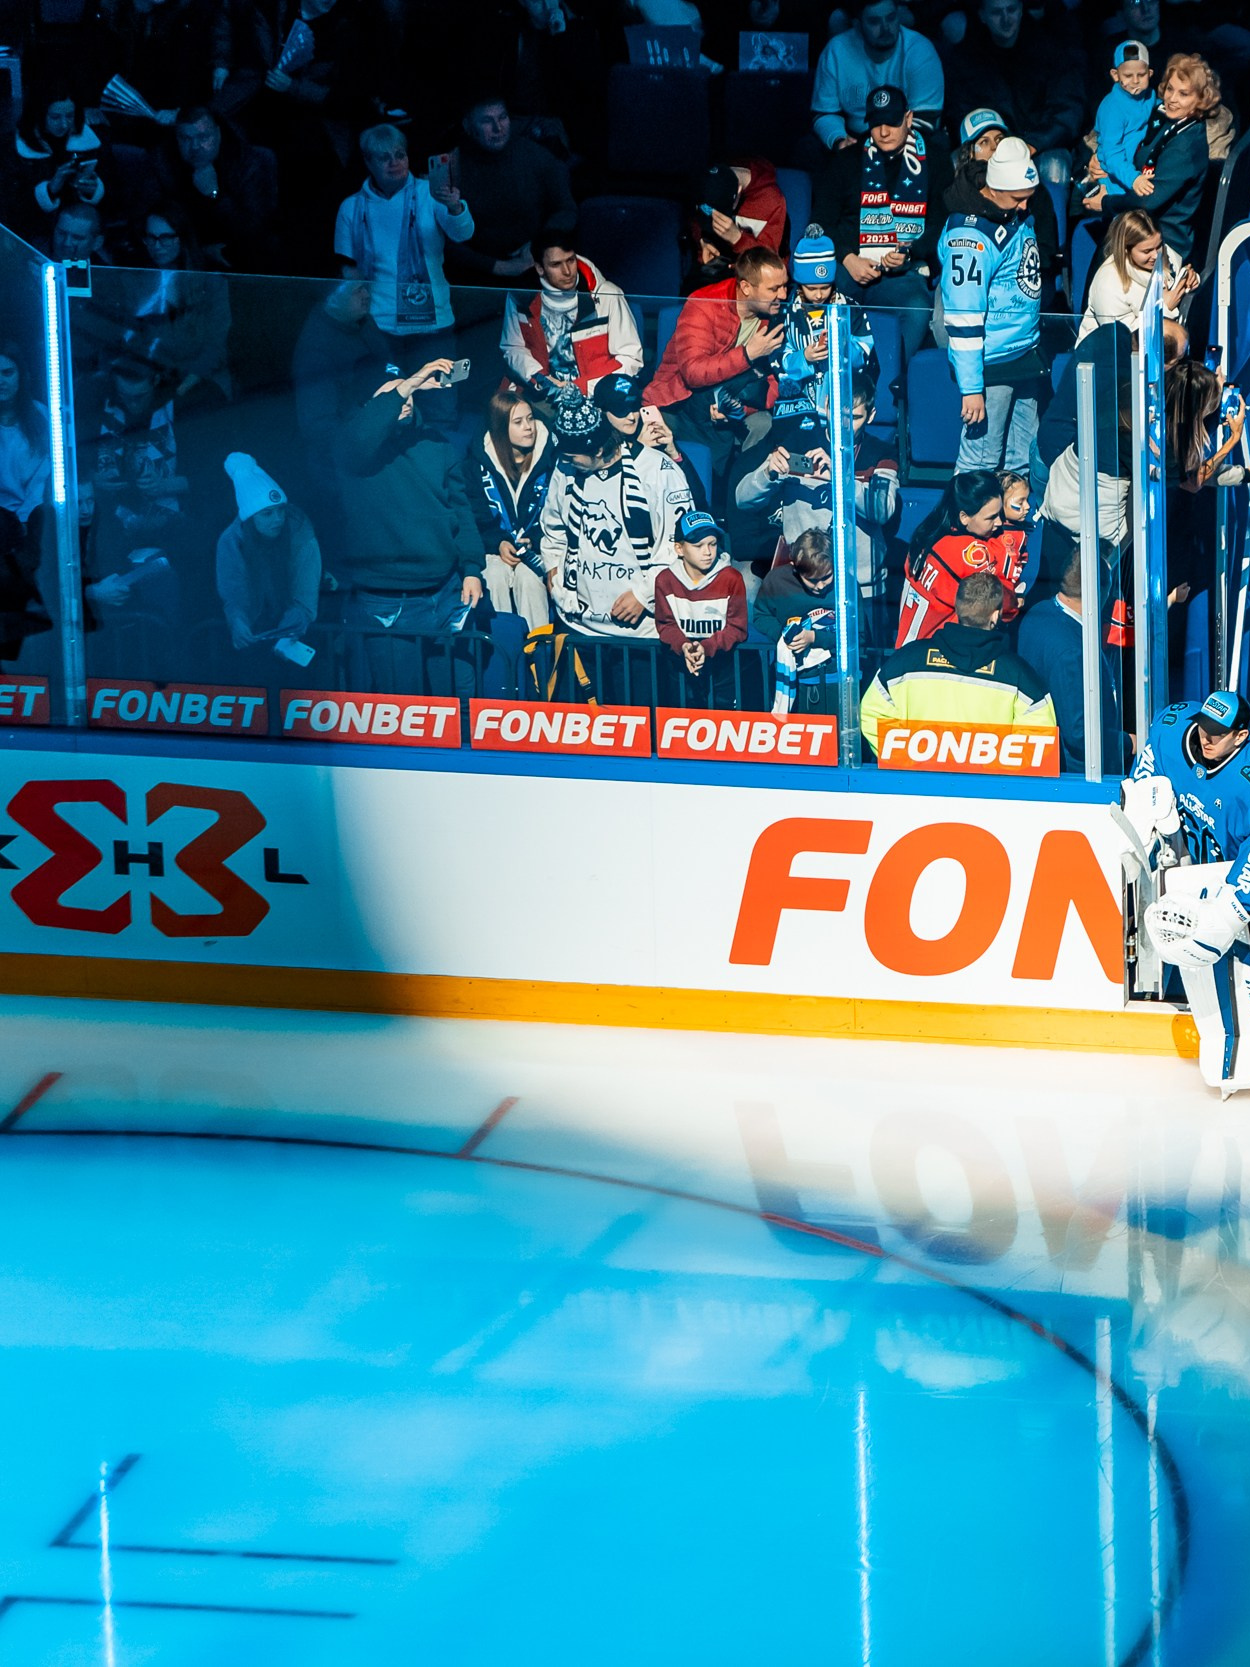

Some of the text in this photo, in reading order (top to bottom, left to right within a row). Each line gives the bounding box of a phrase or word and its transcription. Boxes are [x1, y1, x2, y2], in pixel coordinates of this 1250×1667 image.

[890, 202, 925, 214] FONBET
[866, 234, 890, 243] 2023
[951, 253, 982, 287] 54
[577, 560, 635, 582] РАКТОР
[91, 688, 265, 728] FONBET
[283, 698, 457, 738] FONBET
[473, 708, 646, 748] FONBET
[660, 716, 836, 757] FONBET
[880, 728, 1055, 768] FONBET
